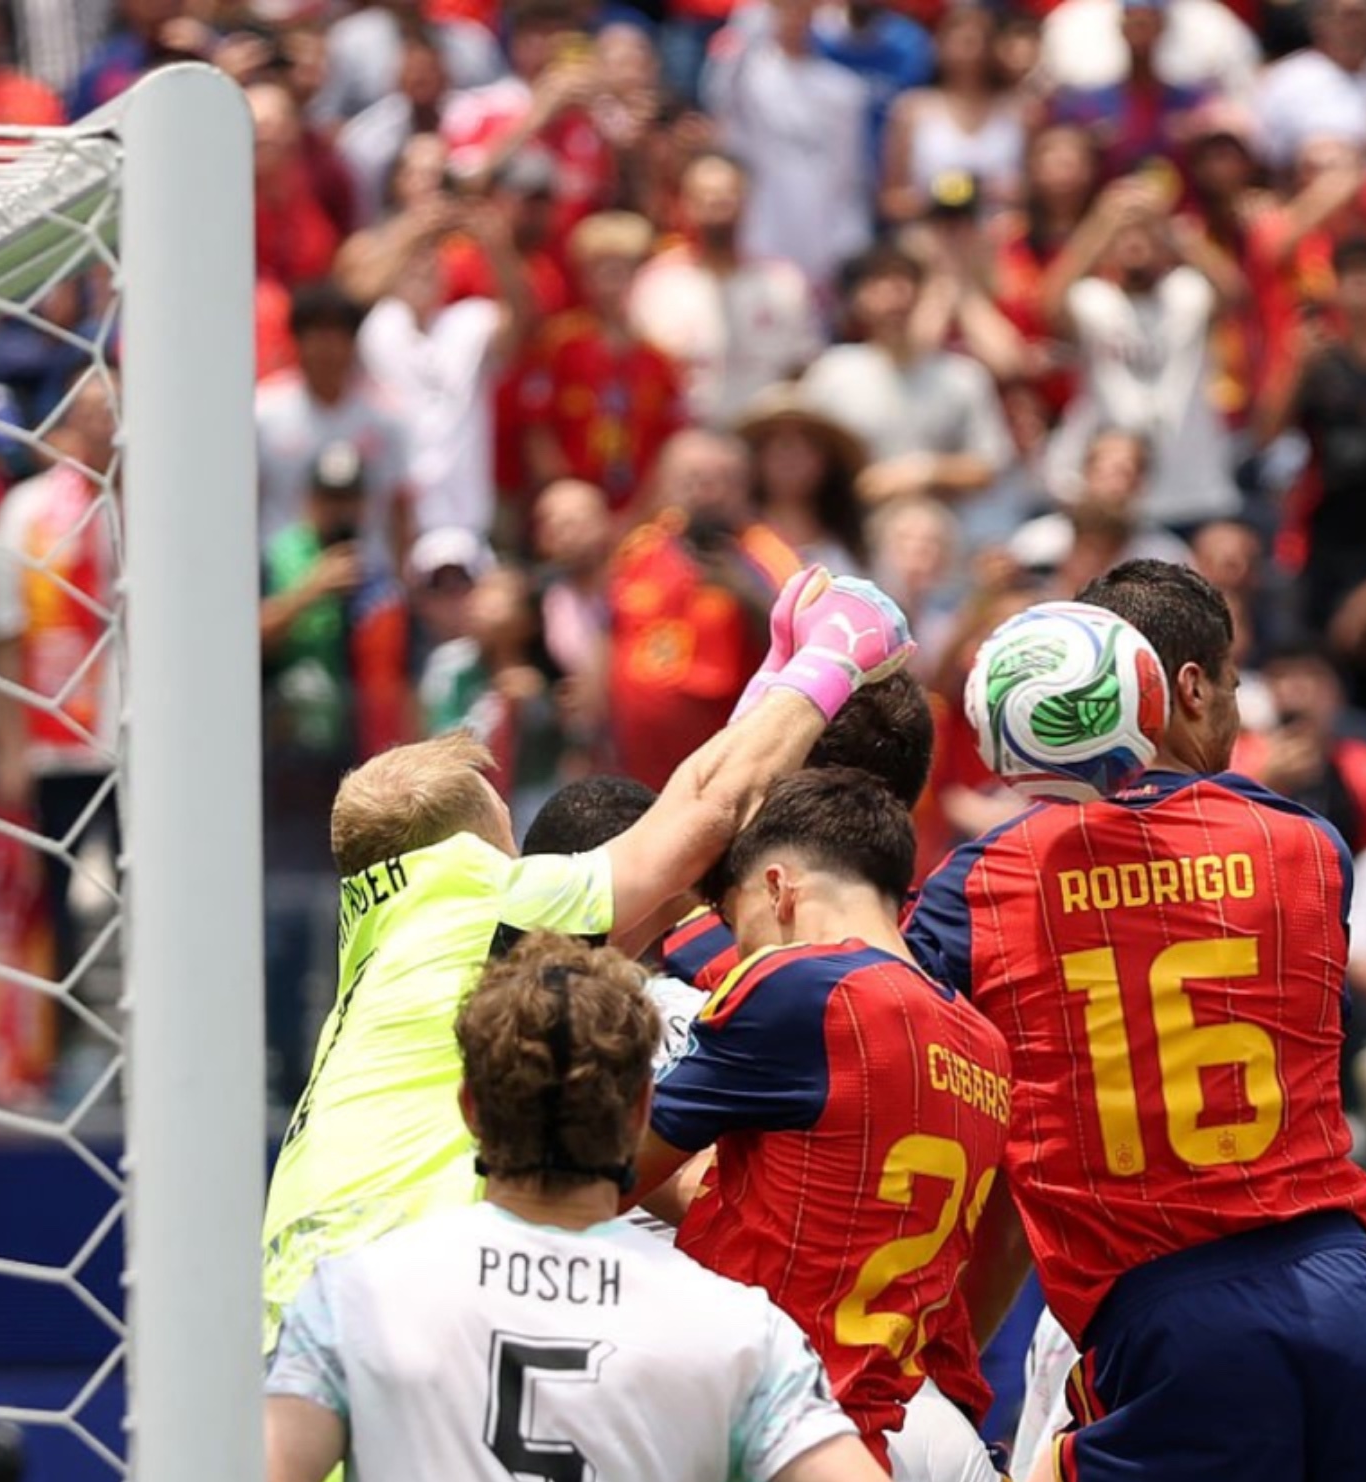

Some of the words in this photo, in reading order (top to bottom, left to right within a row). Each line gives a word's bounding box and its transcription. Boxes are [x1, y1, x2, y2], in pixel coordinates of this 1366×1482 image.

[1057, 852, 1255, 914] RODRIGO
[927, 1042, 1011, 1127] CUBARS
[1060, 936, 1284, 1178] 16
[477, 1246, 621, 1306] POSCH
